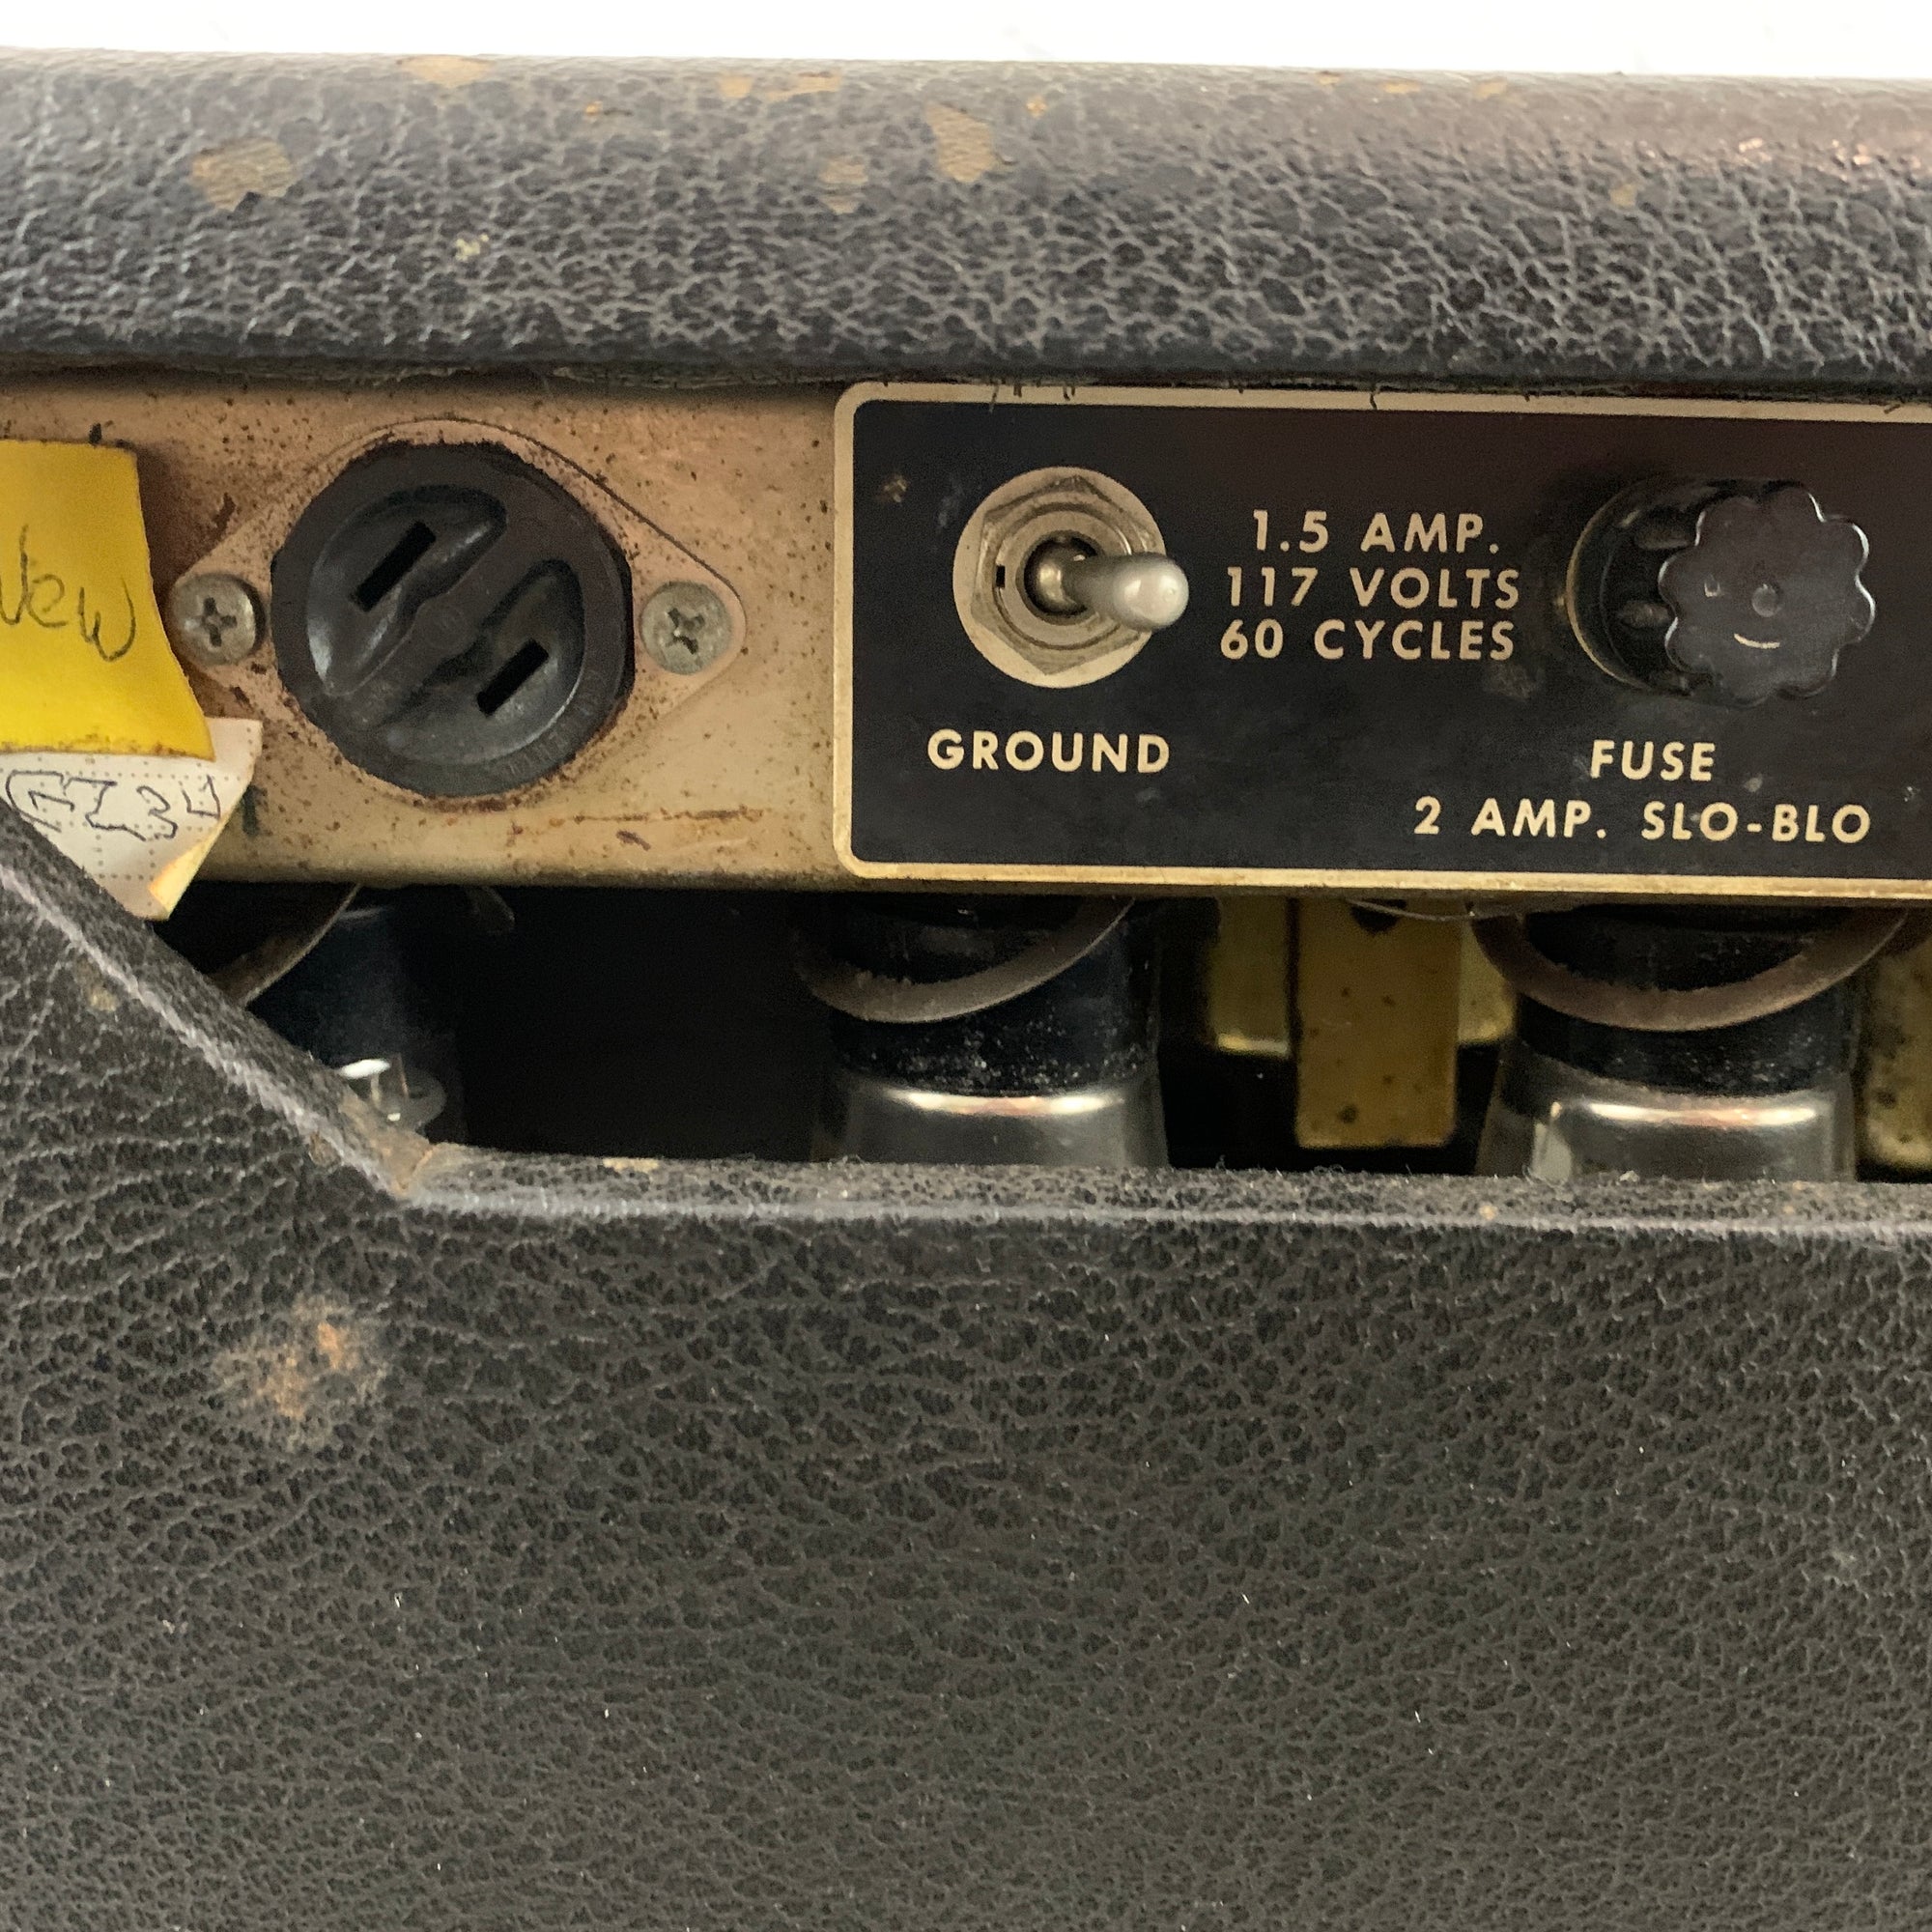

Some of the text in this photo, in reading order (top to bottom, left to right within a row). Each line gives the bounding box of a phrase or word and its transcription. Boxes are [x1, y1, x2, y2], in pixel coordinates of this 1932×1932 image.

[1253, 509, 1499, 554] 1.5 AMP.
[1226, 566, 1520, 611] 117 VOLTS
[1220, 618, 1515, 662] 60 CYCLES
[926, 727, 1170, 774] GROUND
[1589, 739, 1716, 782] FUSE
[1413, 795, 1872, 844] 2 AMP. SLO-BLO
